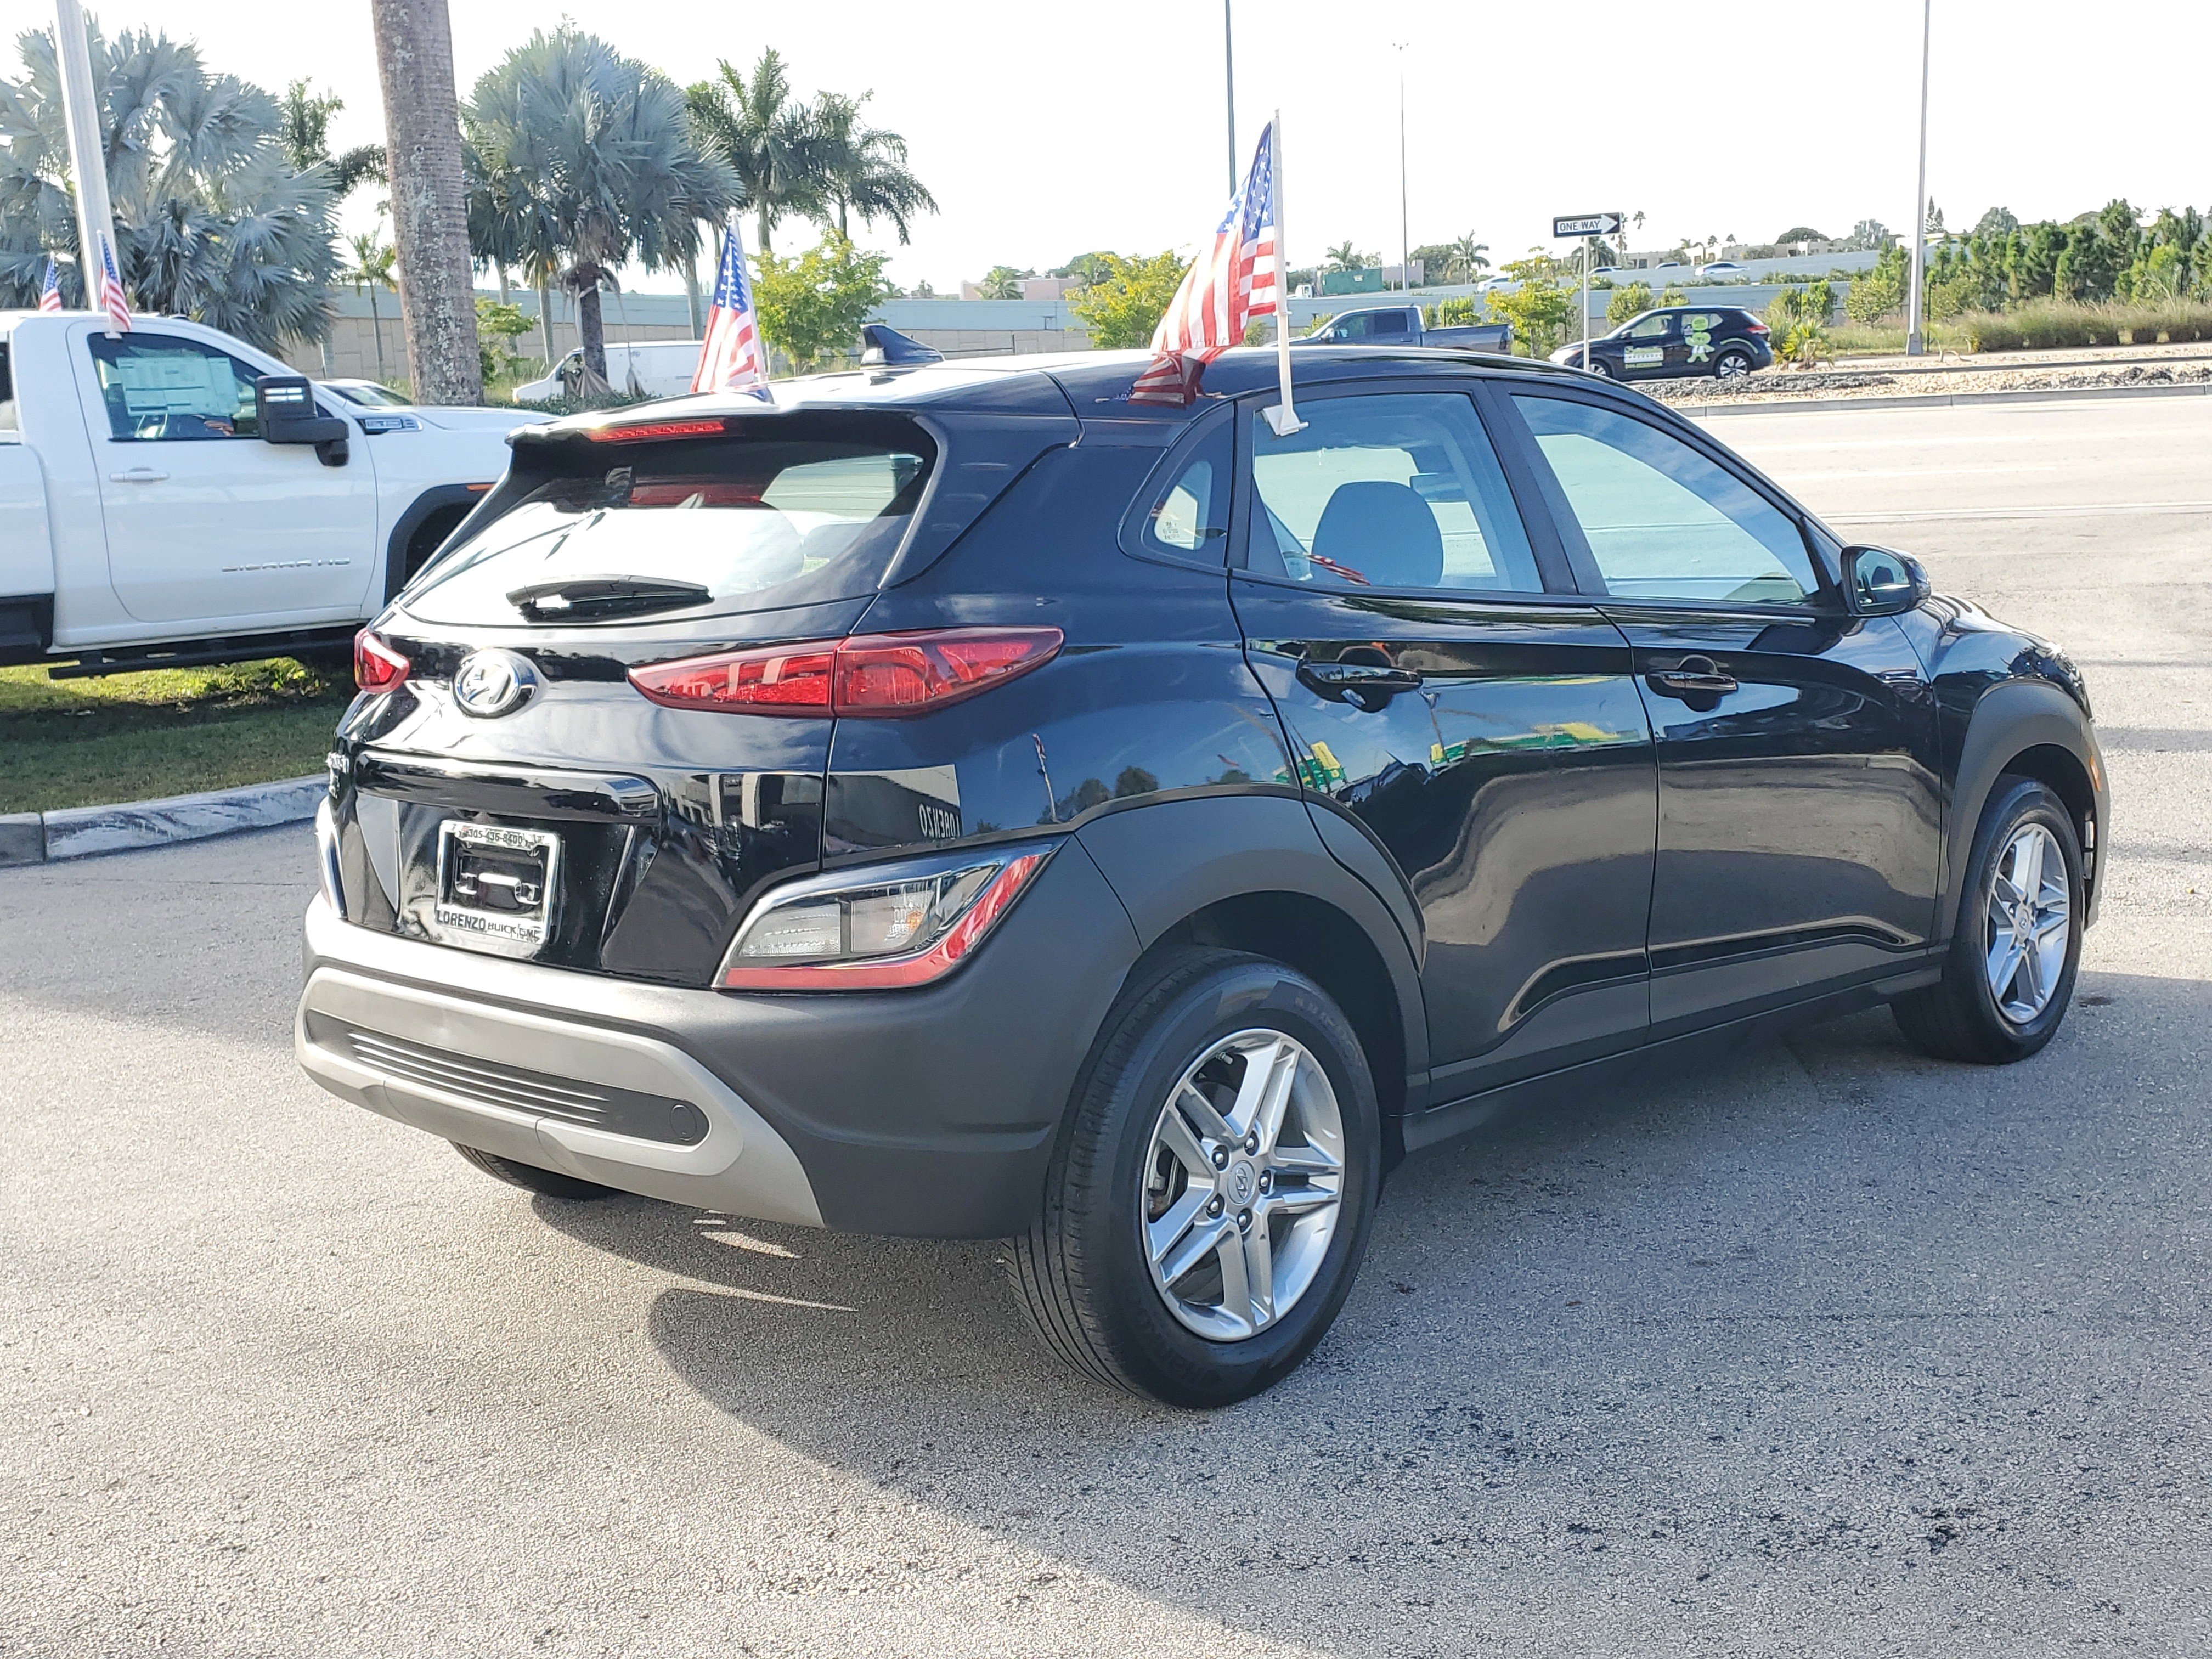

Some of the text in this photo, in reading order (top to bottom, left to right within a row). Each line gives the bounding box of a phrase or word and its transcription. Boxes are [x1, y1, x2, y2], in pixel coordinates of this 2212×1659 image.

[1559, 220, 1601, 232] ONE WAY
[436, 910, 487, 932] LORENZO
[487, 922, 517, 935] BUICK
